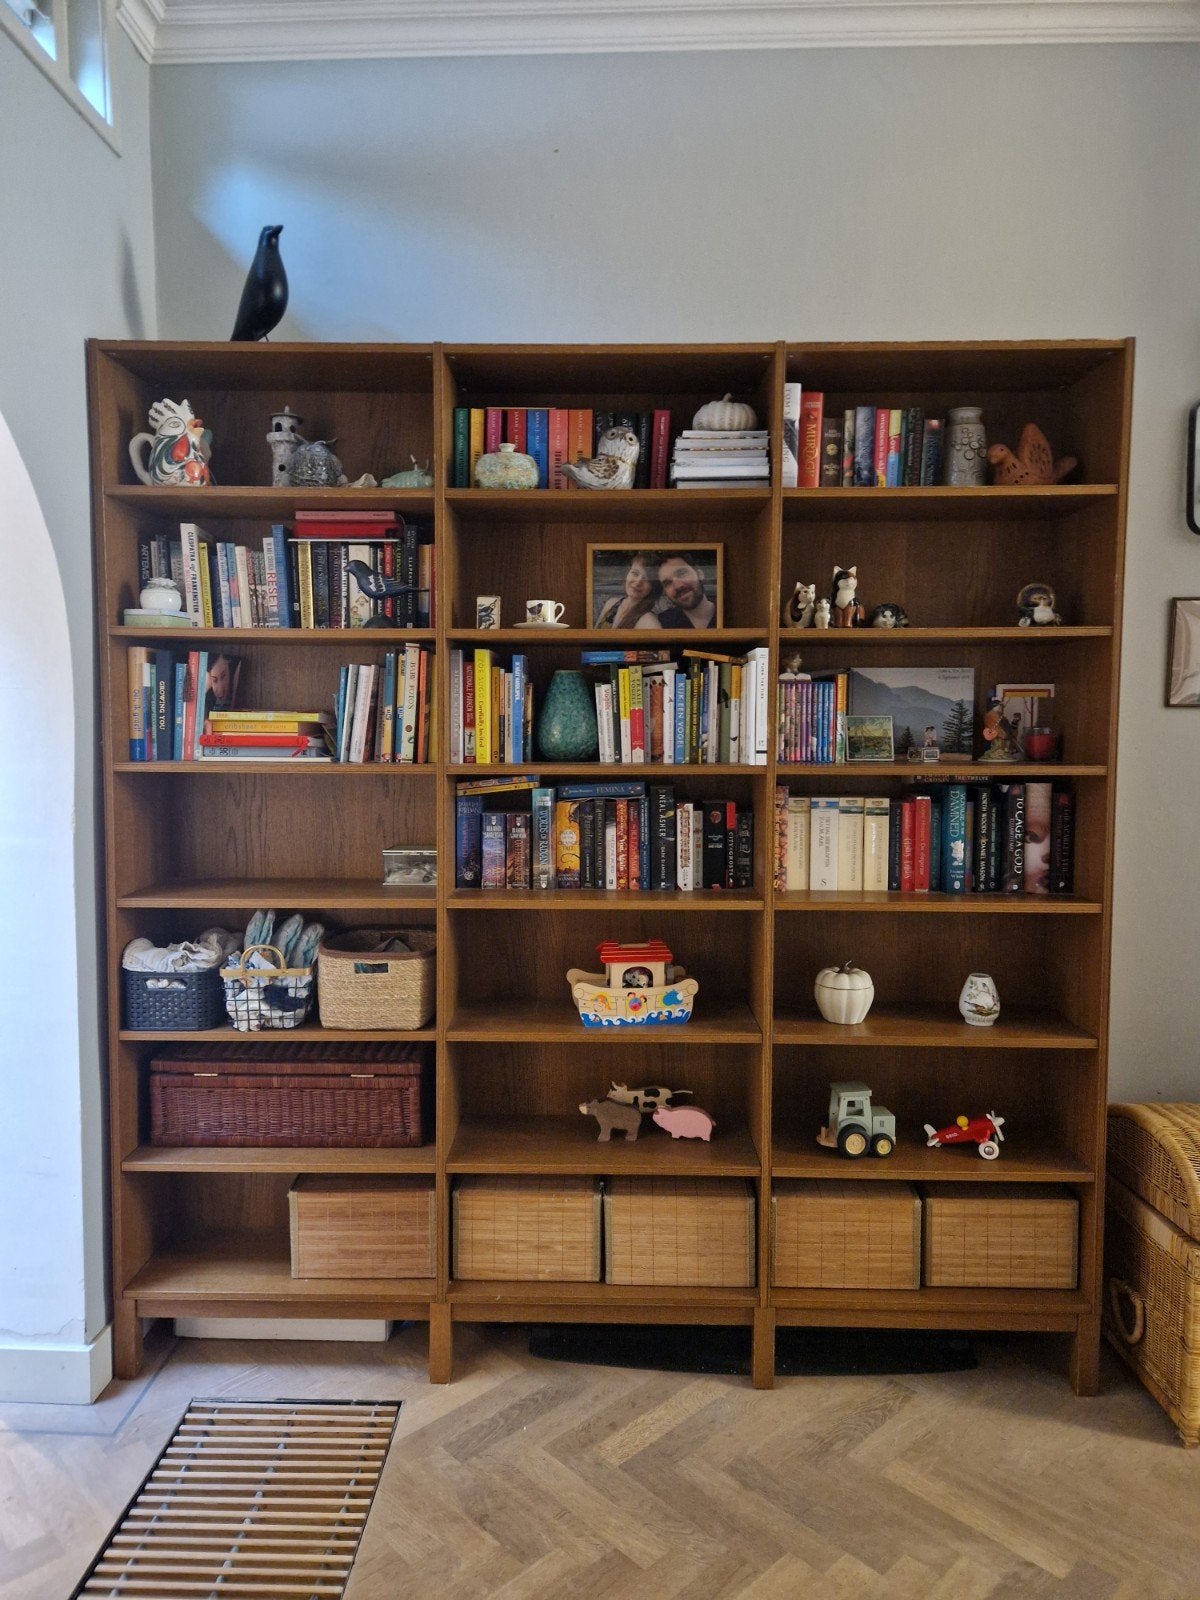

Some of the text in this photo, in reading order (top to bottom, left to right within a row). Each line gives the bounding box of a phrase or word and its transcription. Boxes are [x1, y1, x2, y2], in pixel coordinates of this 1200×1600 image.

[187, 532, 197, 562] CLEOPATRA
[141, 544, 149, 580] ARTEMIS
[190, 574, 200, 614] FRANKENSTEIN
[267, 572, 279, 608] RESET
[677, 722, 685, 748] VOGEL
[596, 786, 625, 795] FEMINA
[1017, 797, 1024, 809] TO
[539, 810, 549, 833] WORDS
[659, 815, 667, 837] ASHER
[949, 791, 960, 838] DAMNED
[1015, 810, 1024, 839] CAGE
[1014, 849, 1023, 874] GOD
